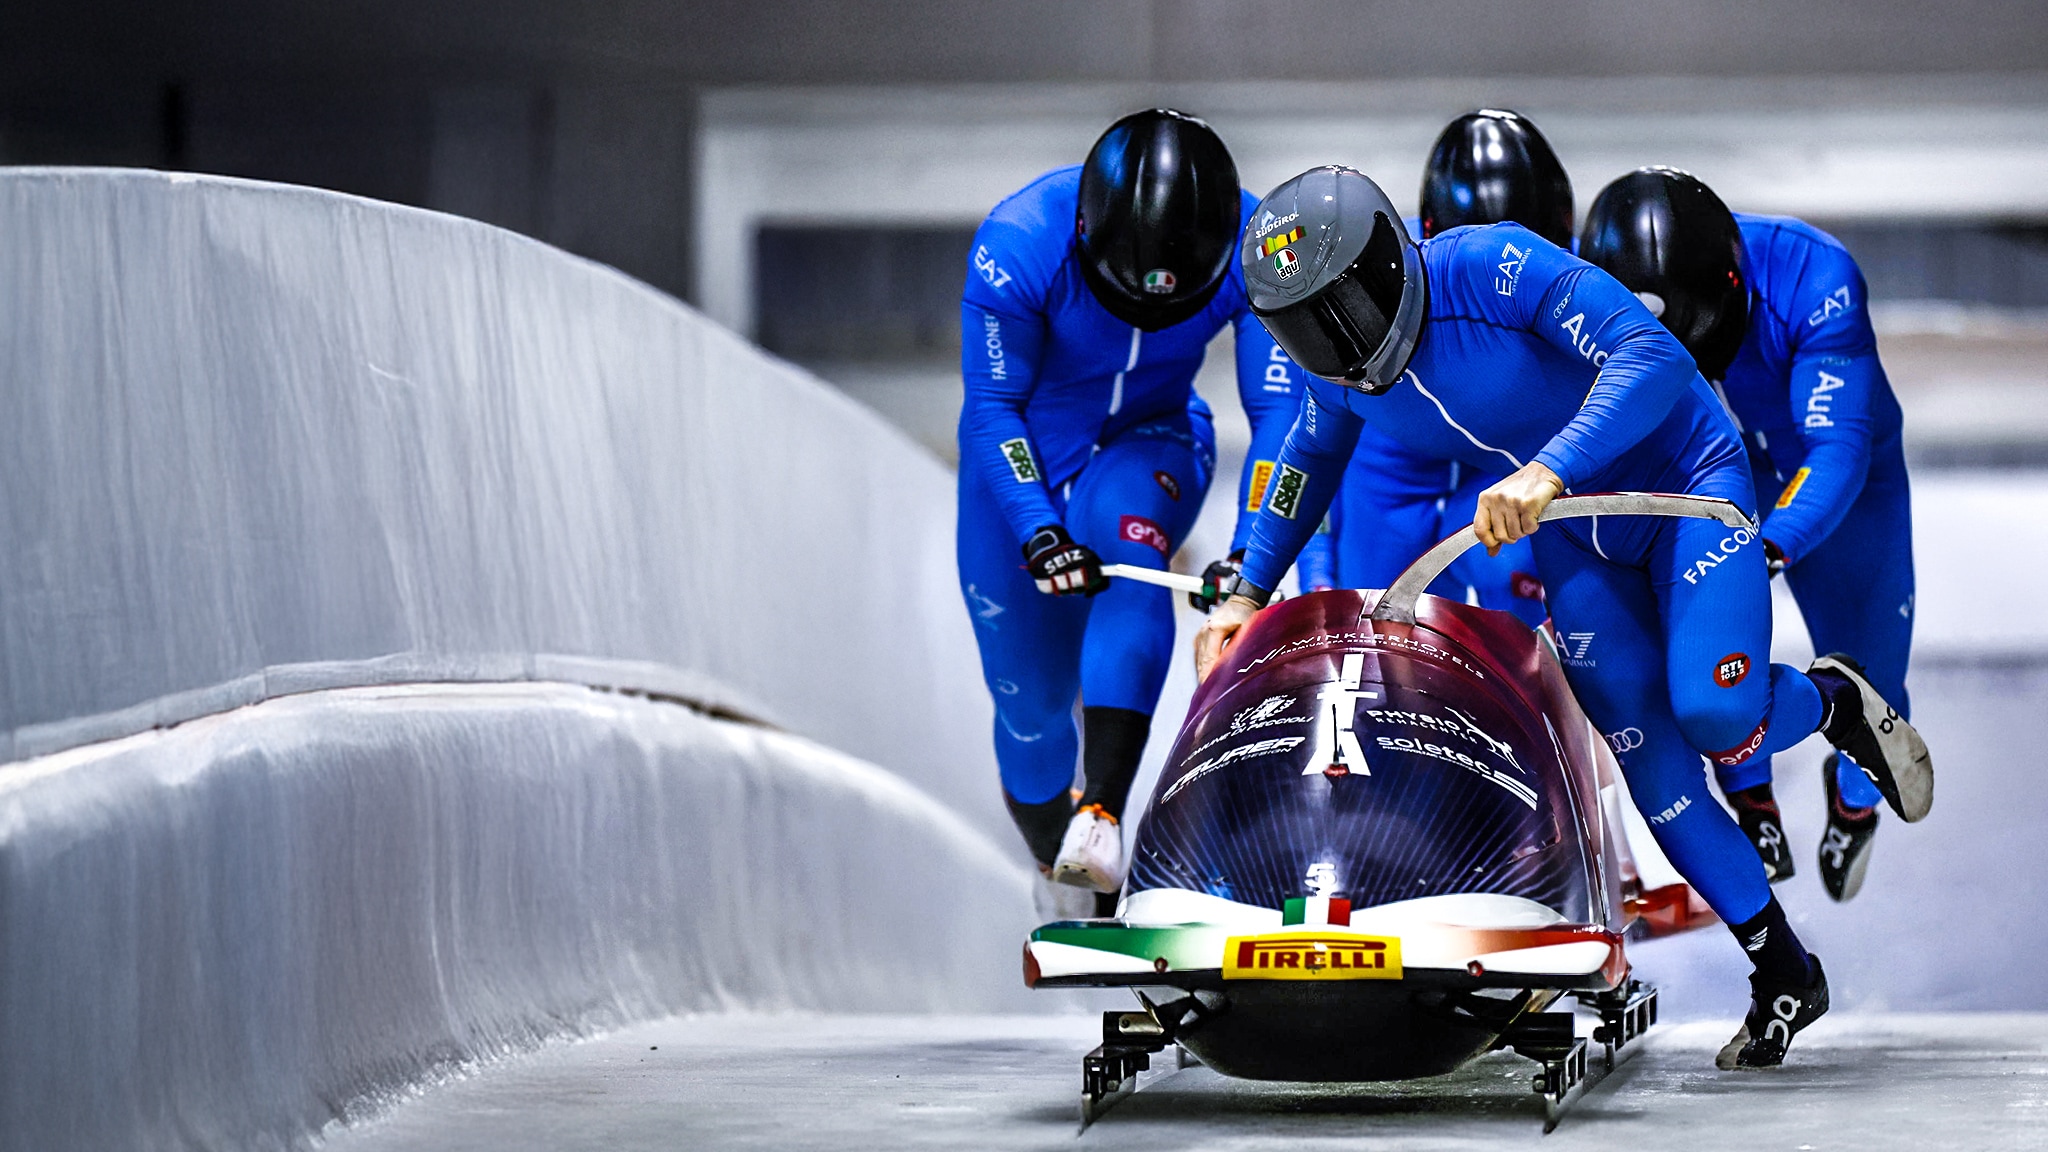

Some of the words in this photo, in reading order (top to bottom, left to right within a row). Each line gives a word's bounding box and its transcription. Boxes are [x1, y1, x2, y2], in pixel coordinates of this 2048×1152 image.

[974, 244, 1012, 288] EA7
[1280, 261, 1298, 278] agv
[1495, 241, 1523, 297] EA7
[1262, 342, 1292, 394] udi
[1043, 548, 1084, 576] SEIZ
[1291, 631, 1485, 680] WINKLERHOTELS
[1555, 630, 1595, 659] A7
[1719, 658, 1745, 676] RTL
[1719, 667, 1746, 682] 102.5
[1366, 709, 1461, 732] PHYSIO
[1376, 736, 1493, 777] soletec
[1304, 863, 1338, 890] 5
[1237, 938, 1387, 970] PIRELLI
